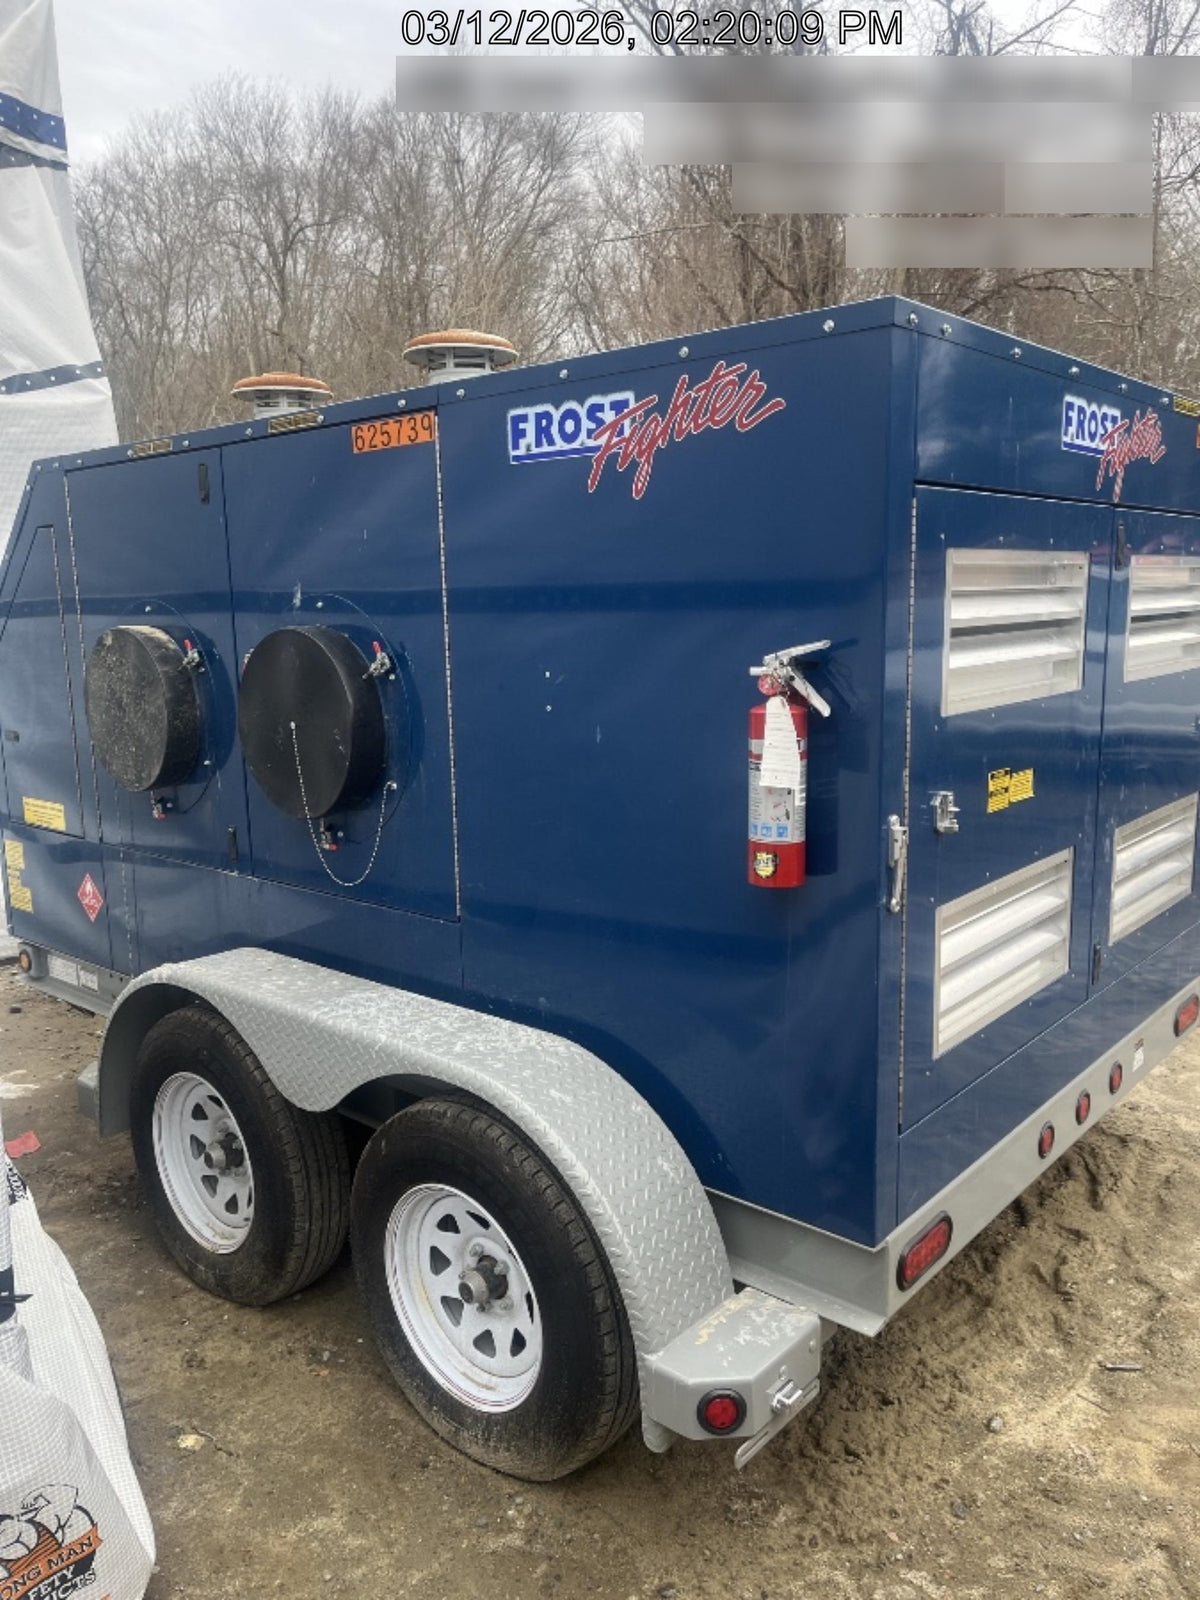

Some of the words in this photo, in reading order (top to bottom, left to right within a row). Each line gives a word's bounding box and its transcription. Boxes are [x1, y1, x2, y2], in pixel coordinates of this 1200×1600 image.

[354, 413, 434, 452] 625739
[509, 393, 634, 455] FROST
[588, 361, 786, 500] Fighter
[1062, 398, 1120, 446] FROST
[1096, 407, 1167, 503] Fighter
[47, 1535, 93, 1571] MAN
